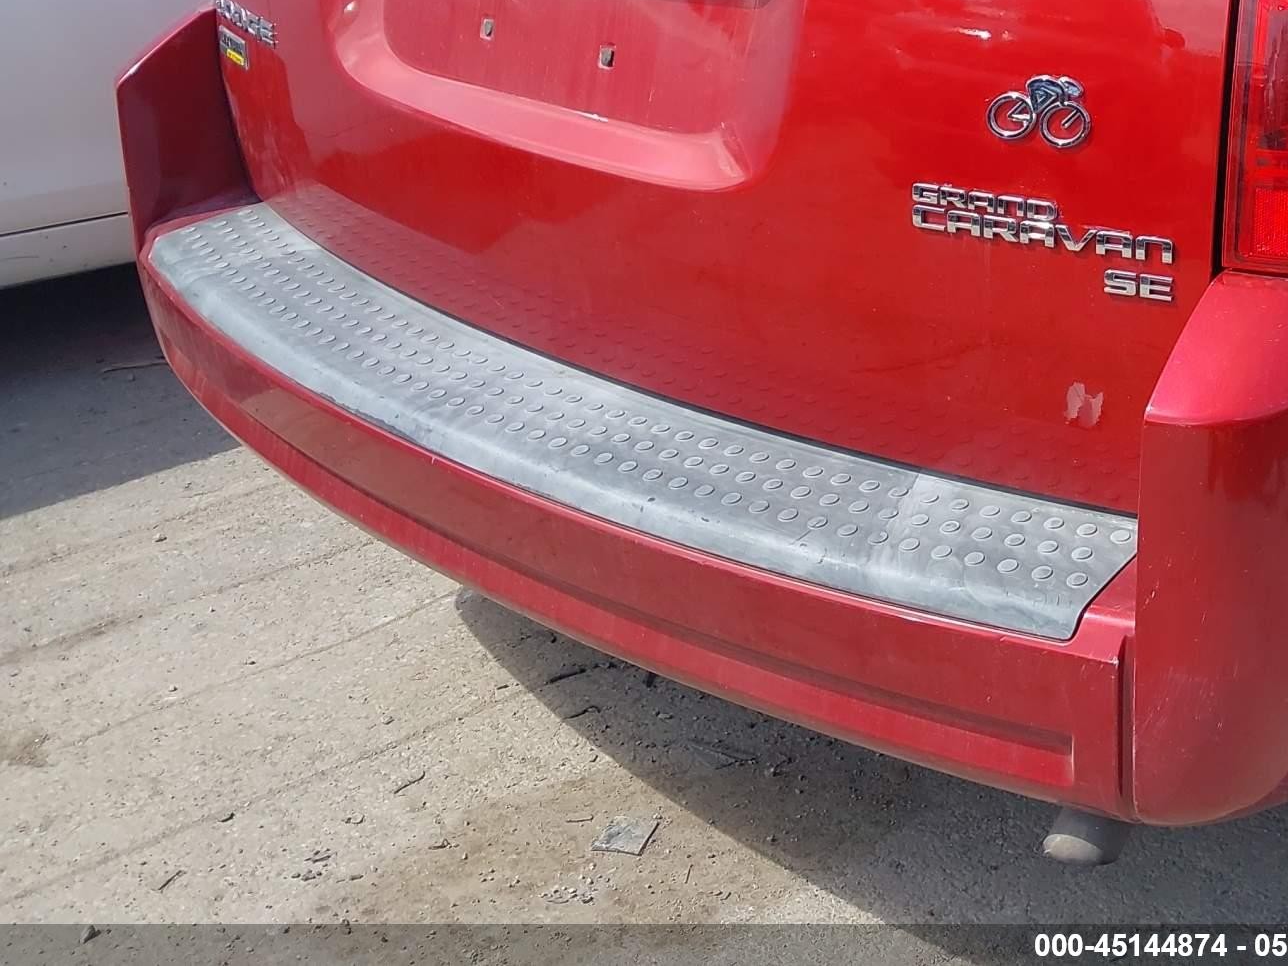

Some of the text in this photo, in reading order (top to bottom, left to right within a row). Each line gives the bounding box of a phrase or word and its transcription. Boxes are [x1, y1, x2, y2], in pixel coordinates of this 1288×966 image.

[912, 182, 1058, 221] GRAND
[912, 204, 1174, 265] CARAVAN
[1103, 269, 1174, 302] SE
